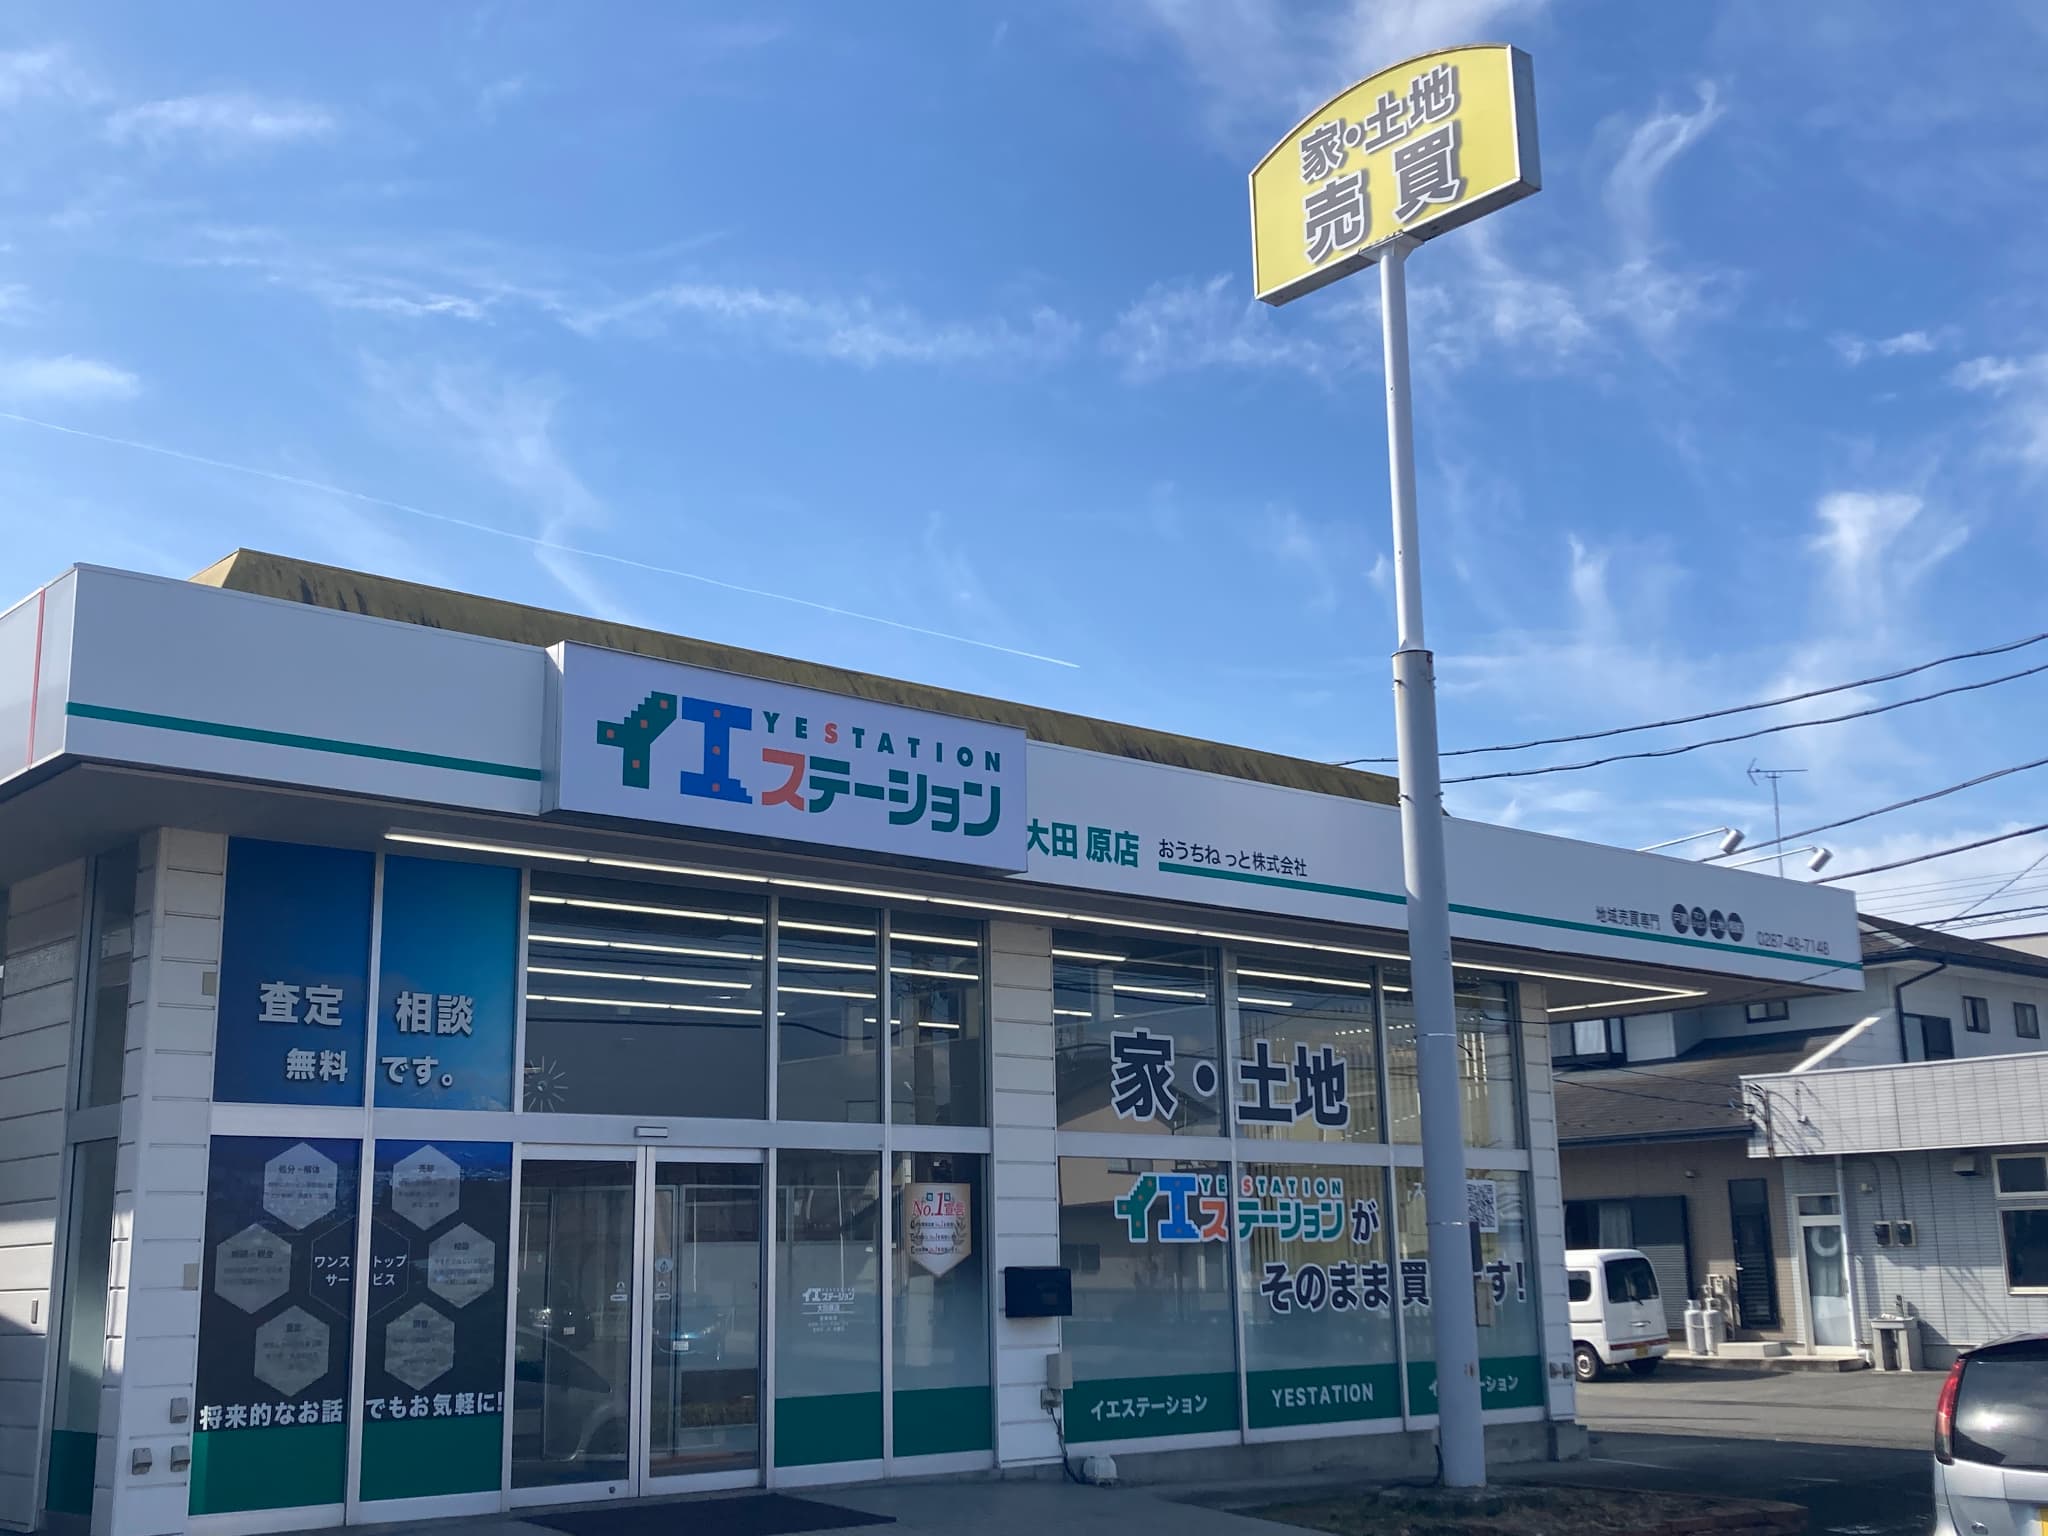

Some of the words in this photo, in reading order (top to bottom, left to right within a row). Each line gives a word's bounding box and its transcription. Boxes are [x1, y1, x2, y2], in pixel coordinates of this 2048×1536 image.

[1301, 64, 1456, 182] 家・土地
[1304, 122, 1461, 262] 売買
[597, 691, 1001, 836] イエステーション
[763, 711, 1000, 772] YESTATION
[1027, 818, 1139, 867] 大田原店
[1159, 839, 1308, 876] おうちねっと株式会社
[259, 981, 343, 1026] 査定
[396, 991, 475, 1036] 相談
[1200, 1174, 1344, 1199] YESTATION
[1091, 1395, 1208, 1421] イエステーション
[1271, 1383, 1374, 1408] YESTATION
